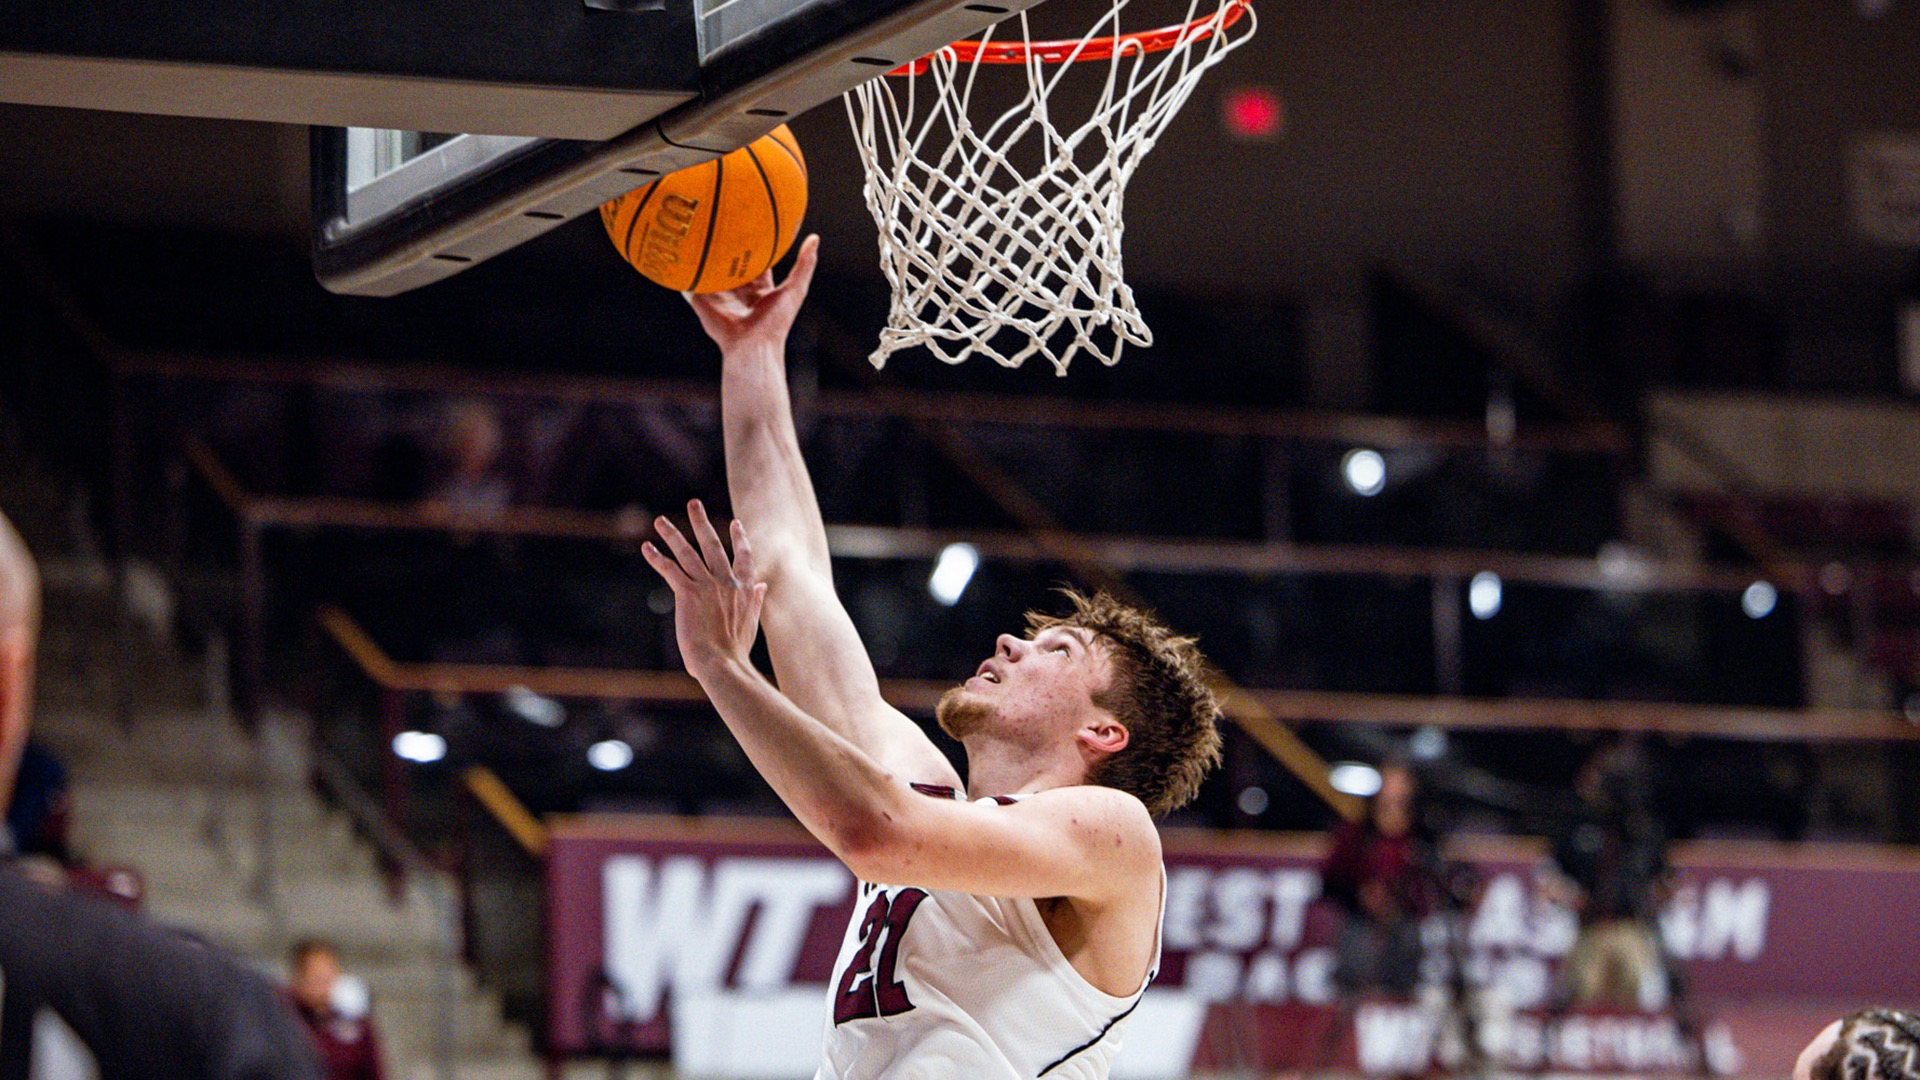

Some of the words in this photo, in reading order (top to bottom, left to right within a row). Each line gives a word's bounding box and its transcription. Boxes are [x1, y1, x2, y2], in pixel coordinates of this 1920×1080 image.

[603, 856, 849, 1022] WT
[834, 887, 929, 1028] 21
[1163, 868, 1323, 951] EST
